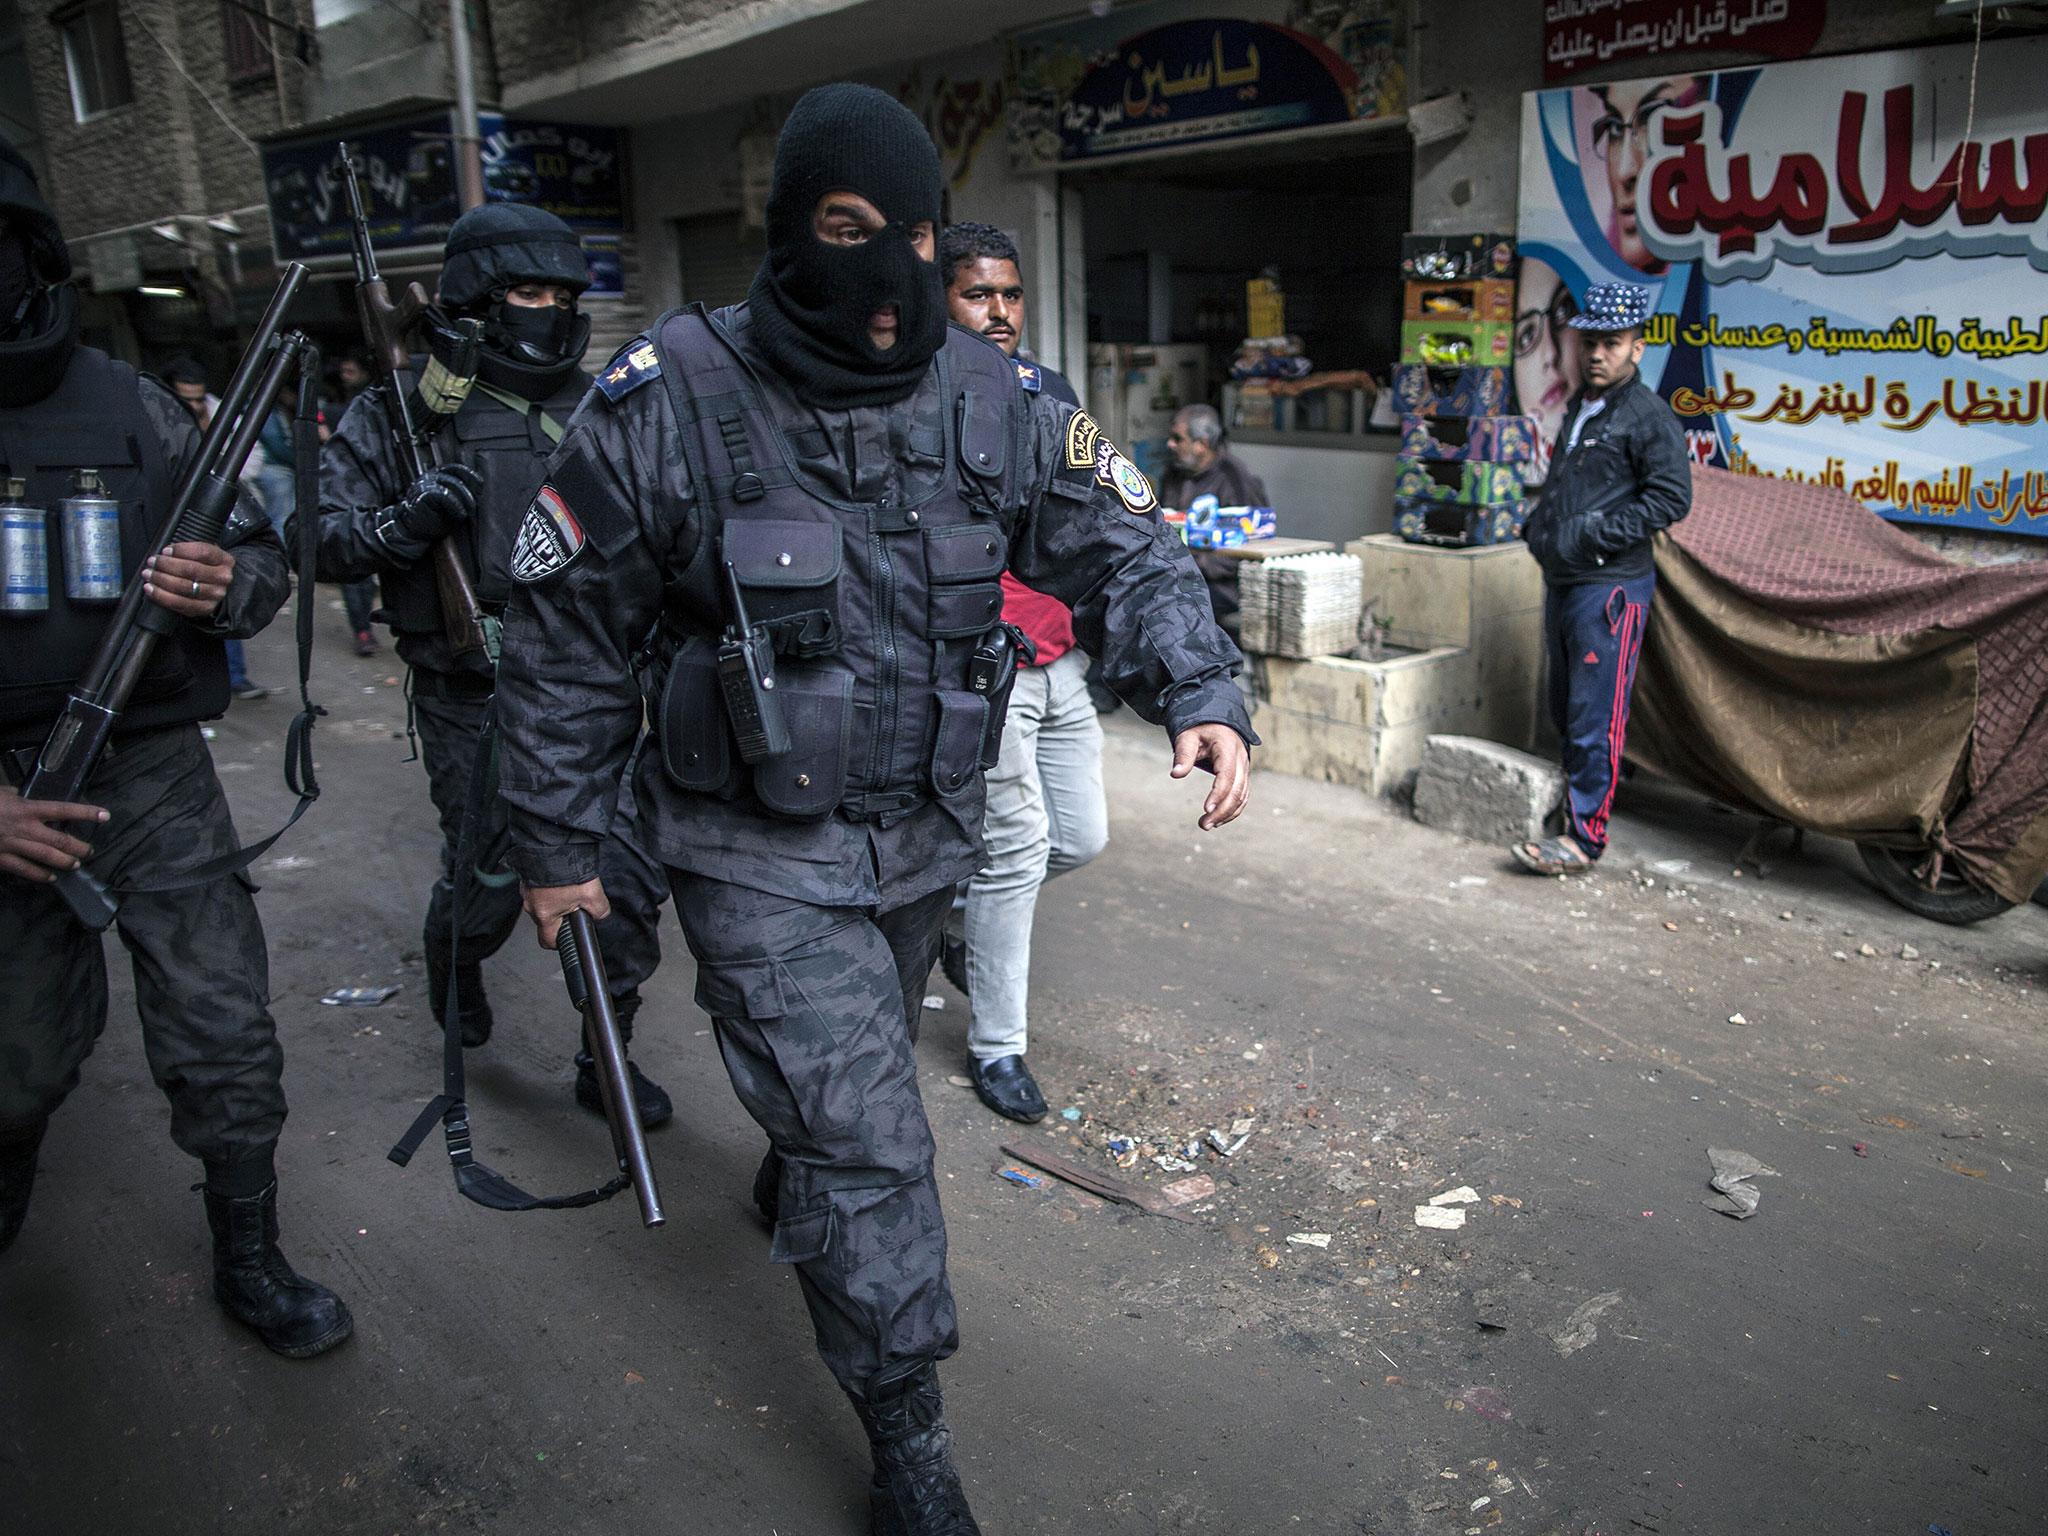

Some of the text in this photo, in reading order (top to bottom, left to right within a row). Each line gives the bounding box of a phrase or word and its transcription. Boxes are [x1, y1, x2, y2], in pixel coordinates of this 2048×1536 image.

[1547, 27, 1595, 68] عليك
[1122, 28, 1261, 119] ياسين
[1681, 315, 1804, 354] وعدسات
[1807, 315, 1954, 358] والشمسية
[1097, 442, 1115, 478] POLICE
[526, 512, 563, 566] EGYPT
